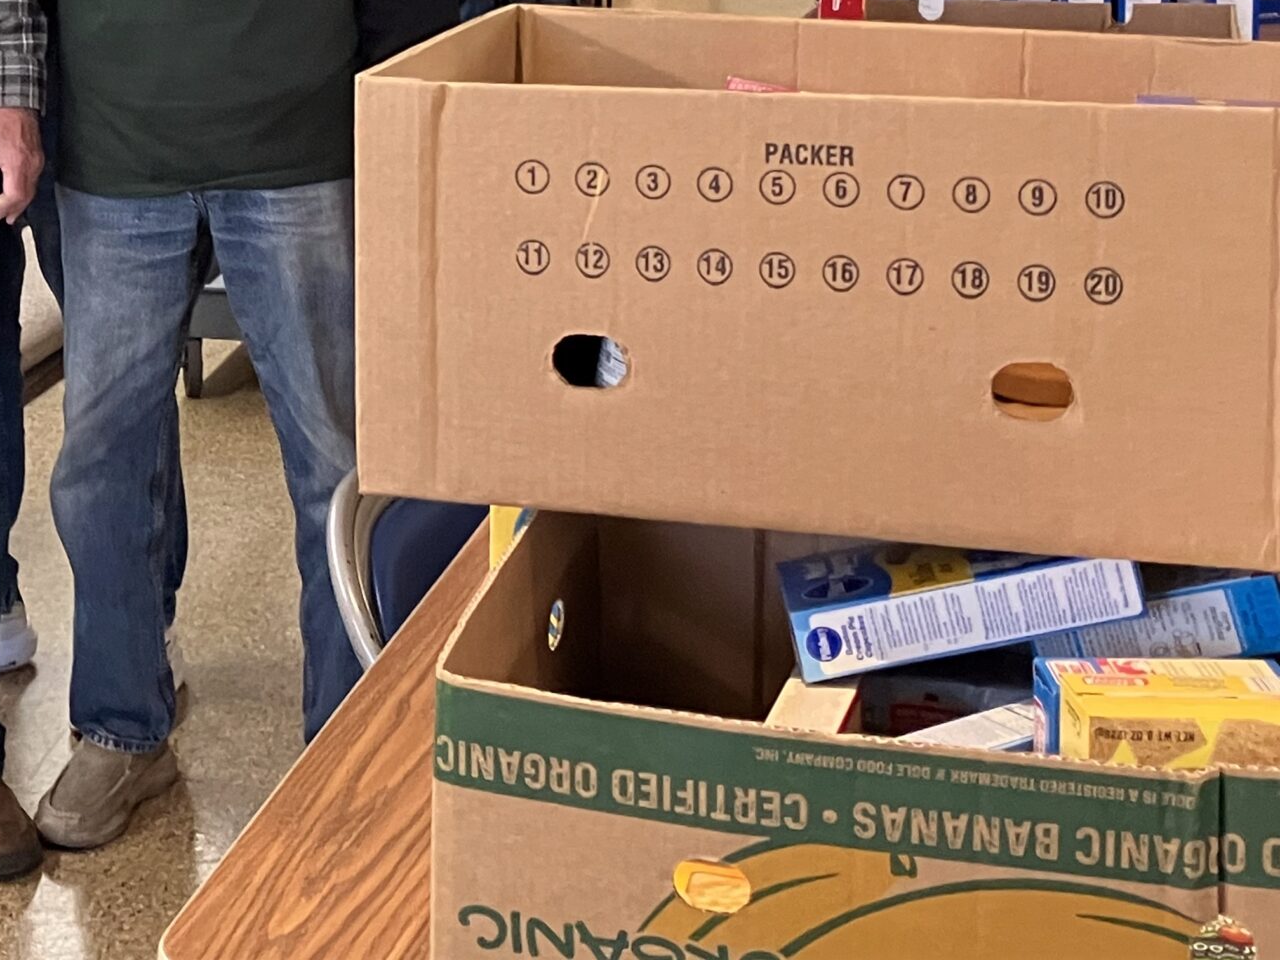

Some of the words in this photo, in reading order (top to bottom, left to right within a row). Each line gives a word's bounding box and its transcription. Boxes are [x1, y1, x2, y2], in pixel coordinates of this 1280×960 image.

[765, 142, 854, 167] PACKER
[1091, 188, 1117, 210] 10
[521, 245, 543, 267] 11
[580, 248, 604, 269] 12
[640, 251, 664, 272] 13
[701, 254, 727, 276] 14
[765, 258, 789, 279] 15
[827, 261, 854, 282] 16
[892, 264, 918, 286] 17
[957, 267, 984, 289] 18
[1023, 270, 1050, 292] 19
[1089, 273, 1118, 296] 20
[1130, 729, 1144, 741] OZ
[1158, 730, 1172, 742] WT
[1176, 731, 1195, 742] NET
[435, 734, 598, 799] ORGANIC
[857, 759, 893, 776] FOOD
[896, 763, 931, 780] DOLE
[950, 769, 1035, 791] TRADEMARK
[1040, 779, 1124, 801] REGISTERED
[611, 769, 808, 831] CERTIFIED
[1127, 789, 1138, 803] A
[1142, 792, 1157, 805] IS
[853, 801, 1060, 861] BANANAS
[458, 904, 782, 960] GANIC
